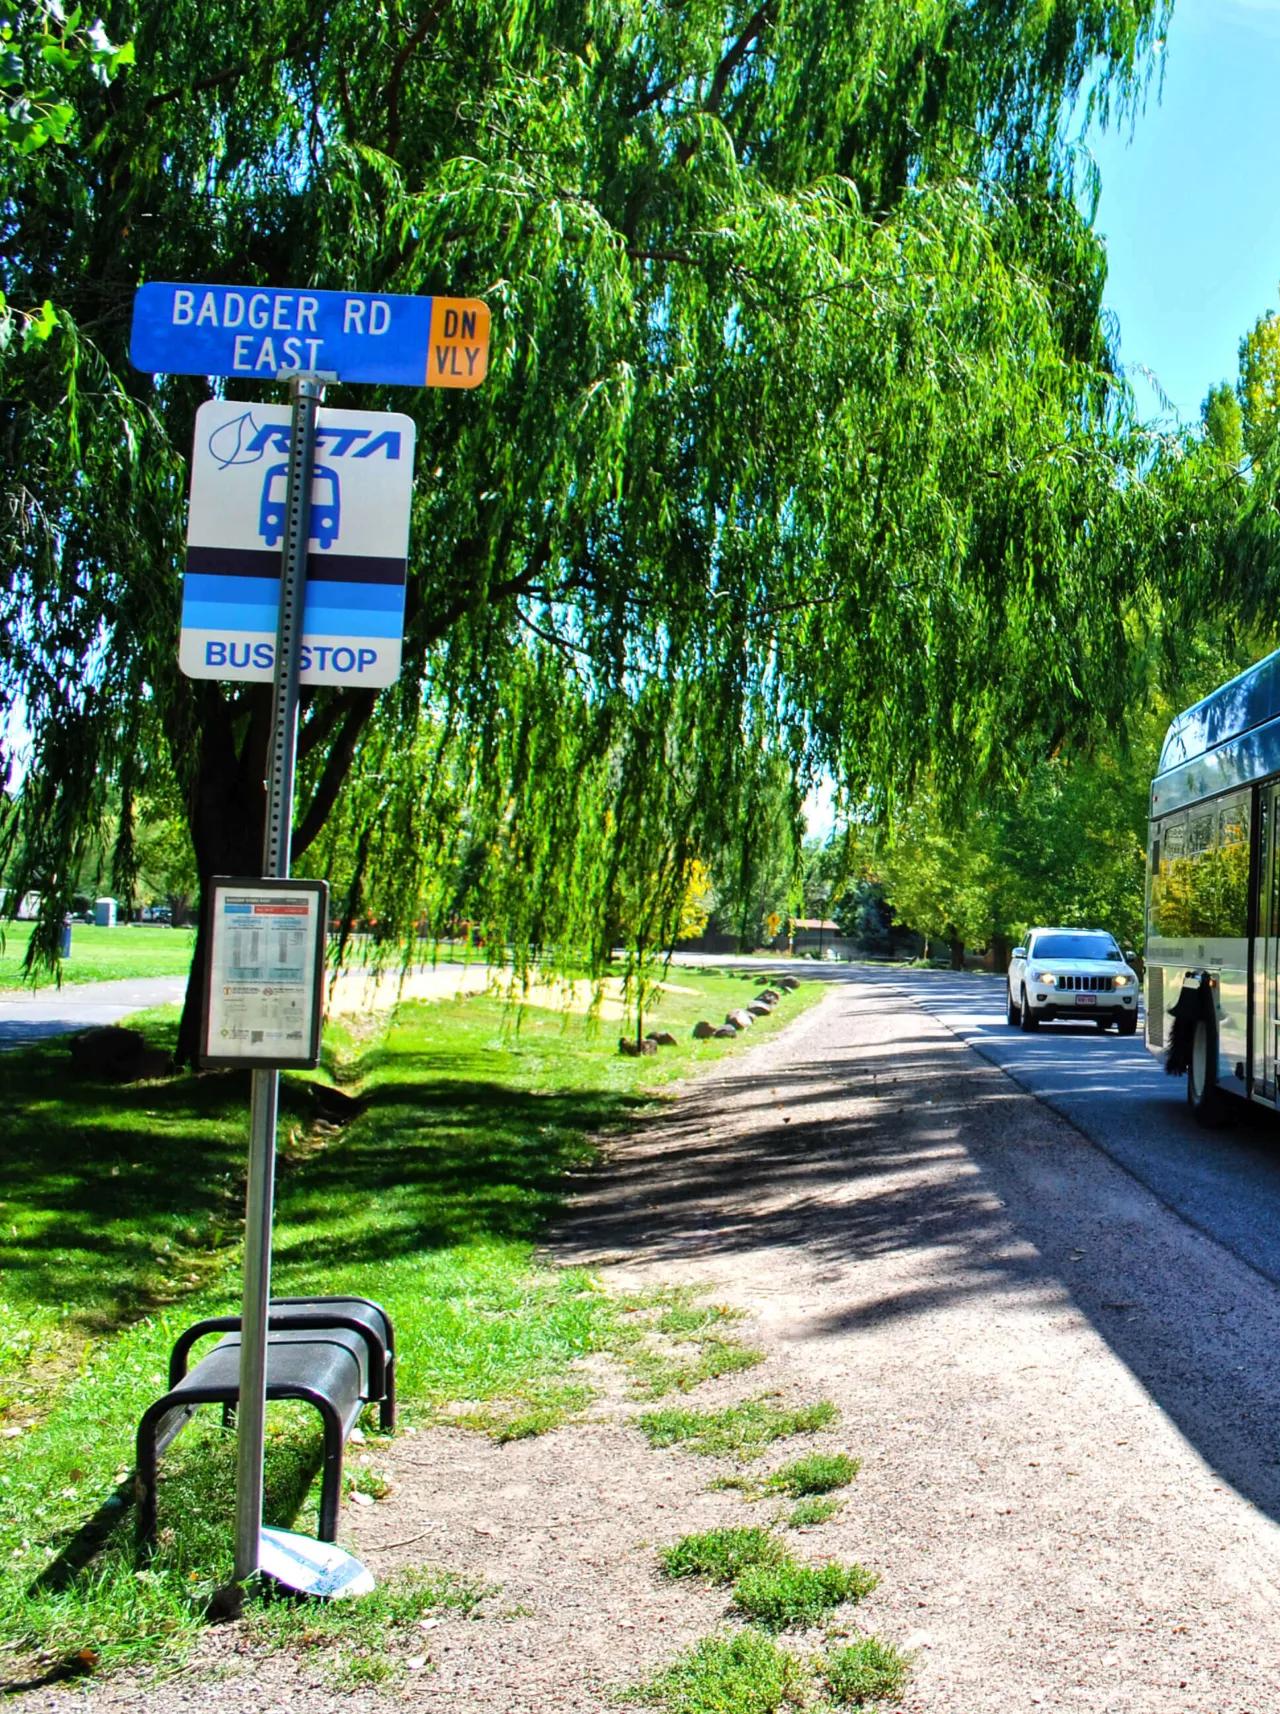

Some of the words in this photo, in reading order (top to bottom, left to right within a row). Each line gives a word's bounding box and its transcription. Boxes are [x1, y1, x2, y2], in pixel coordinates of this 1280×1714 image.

[173, 290, 319, 332] BADGER
[343, 299, 391, 335] RD
[443, 309, 477, 339] DN
[232, 335, 324, 371] EAST
[436, 345, 480, 376] VLY
[205, 641, 275, 669] BUS
[300, 644, 378, 673] STOP
